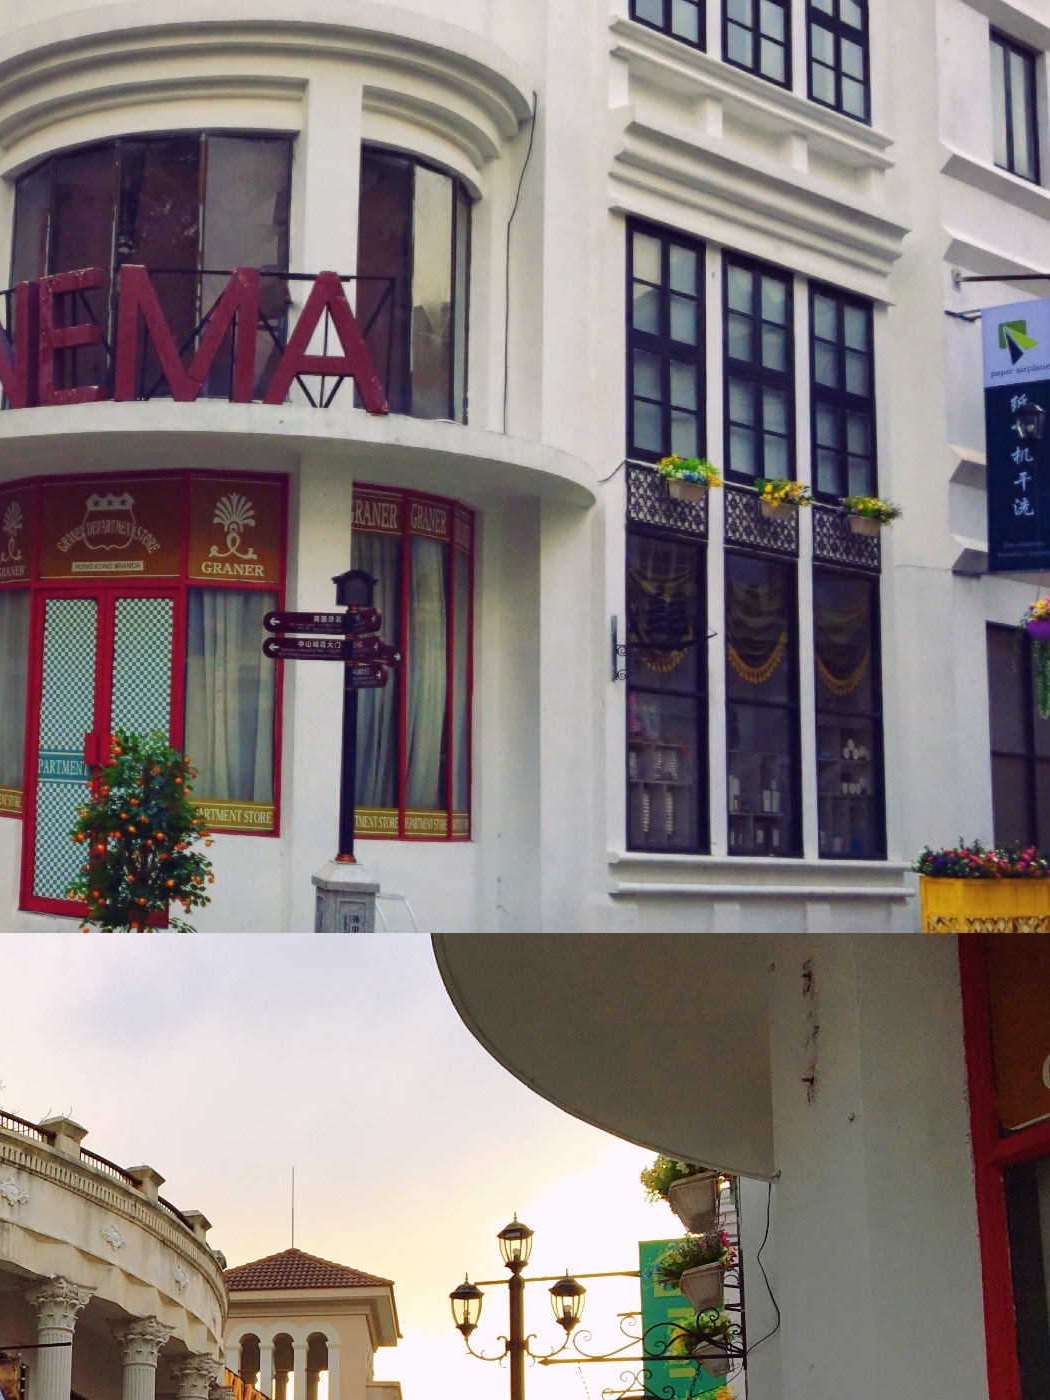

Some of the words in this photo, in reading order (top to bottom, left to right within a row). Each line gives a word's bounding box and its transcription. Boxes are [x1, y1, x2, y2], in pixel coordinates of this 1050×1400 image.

[990, 368, 1014, 379] paper
[1010, 394, 1034, 516] 纸机干洗
[410, 503, 447, 534] GRANER
[86, 518, 136, 537] DEPARTMENT
[134, 526, 161, 554] STORE
[74, 562, 93, 571] HONG
[94, 562, 113, 571] KONG
[113, 562, 141, 571] BRANCH
[201, 561, 265, 577] GRANER
[38, 758, 88, 776] PARTMENT
[243, 809, 272, 825] STORE
[379, 816, 399, 829] STORE
